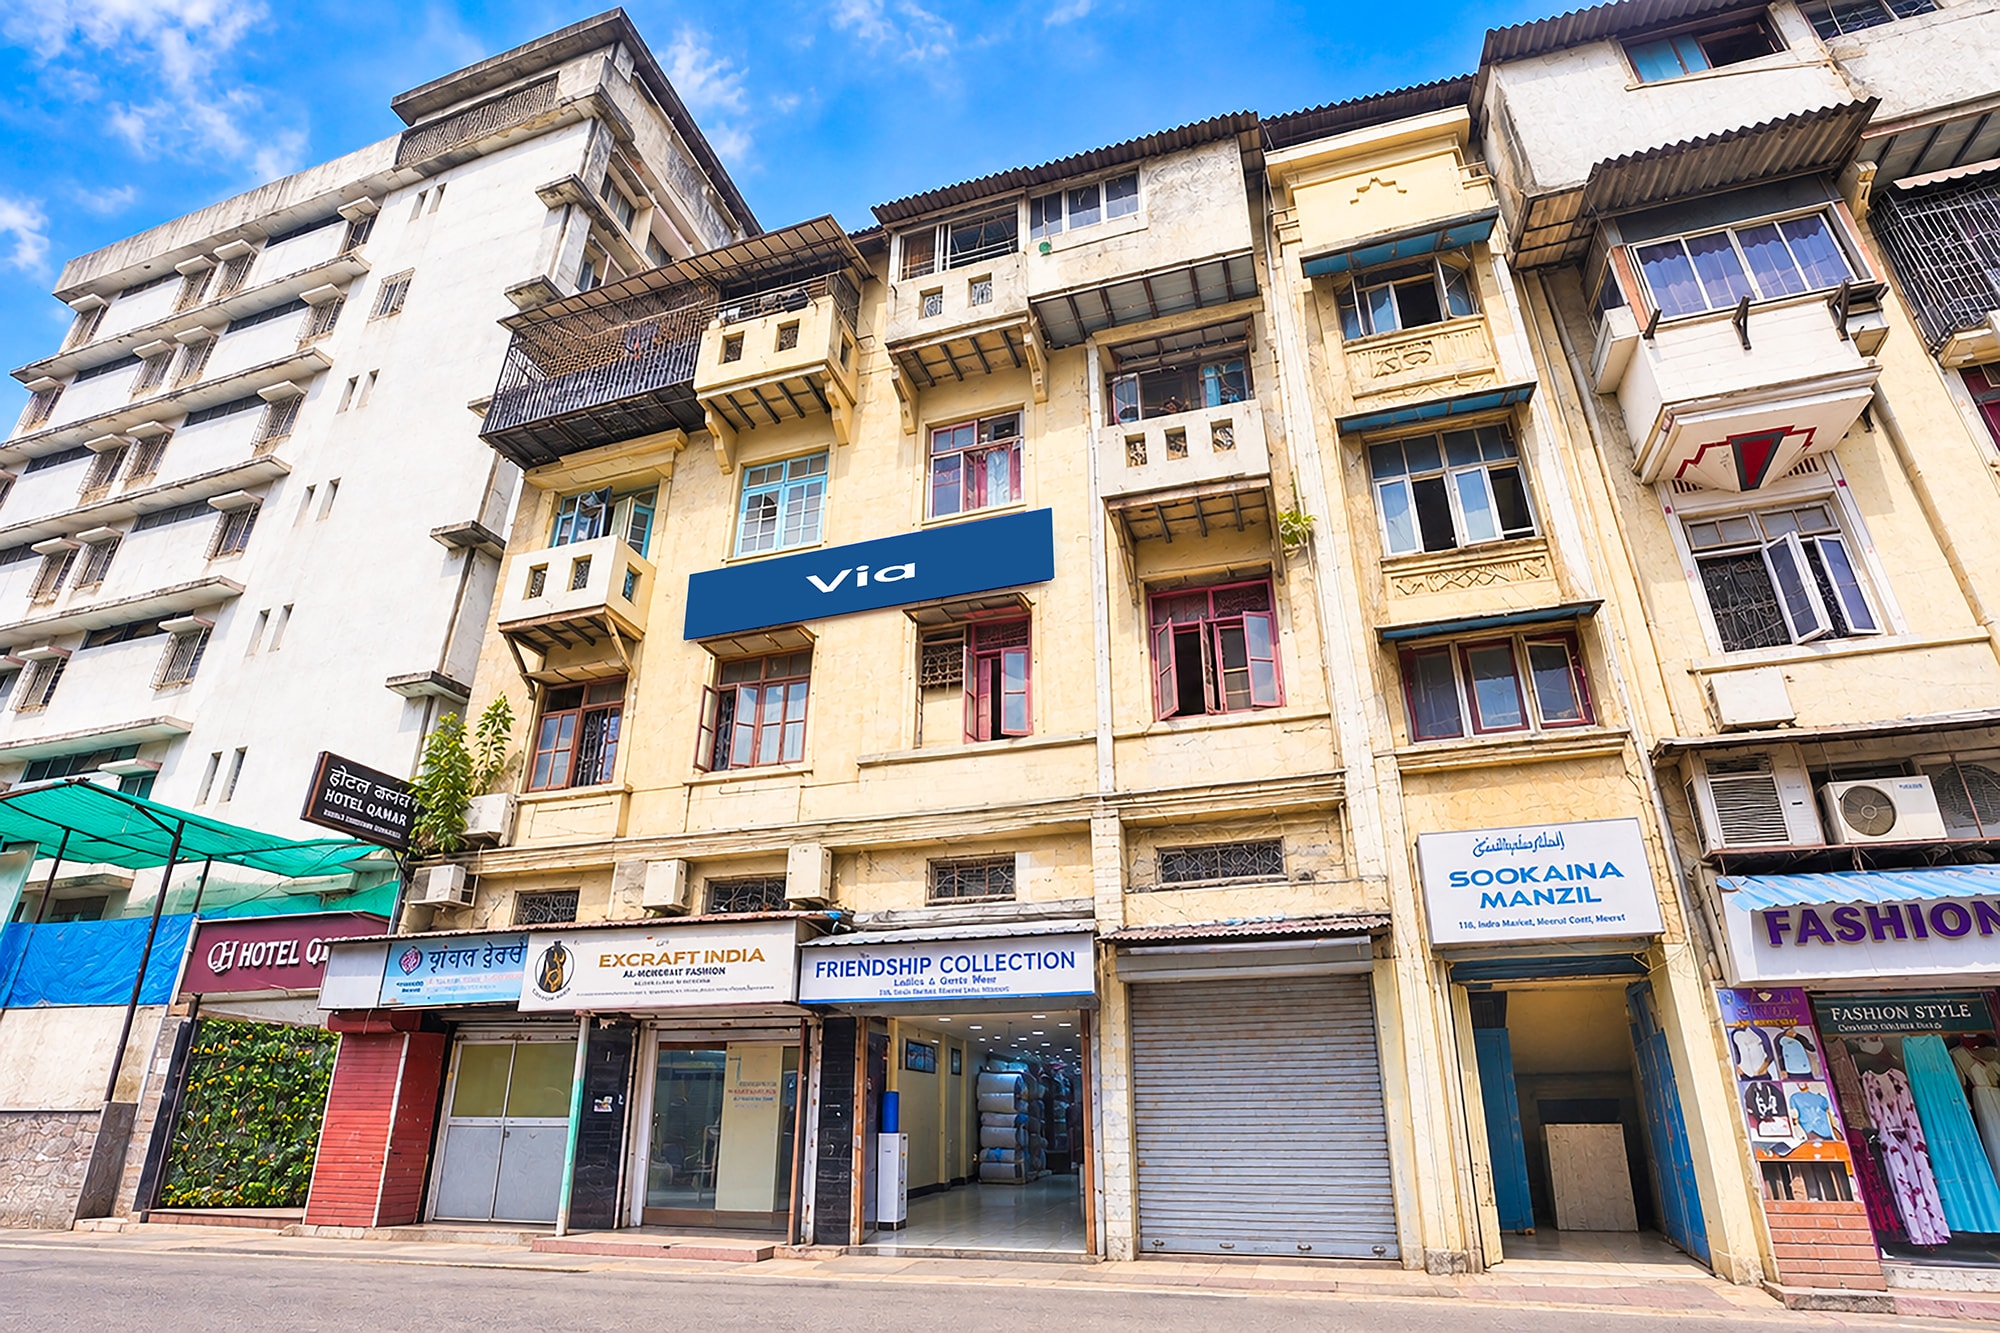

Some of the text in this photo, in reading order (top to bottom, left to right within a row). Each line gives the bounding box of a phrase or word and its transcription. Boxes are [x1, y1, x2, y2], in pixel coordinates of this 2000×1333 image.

[806, 562, 916, 594] Via
[329, 765, 372, 795] होटल
[324, 788, 364, 813] HOTEL
[366, 803, 408, 827] QAMAR
[1449, 861, 1625, 888] SOOKAINA
[1480, 886, 1602, 909] MANZIL
[238, 940, 300, 967] HOTEL
[598, 948, 766, 968] EXCRAFT INDIA
[815, 951, 1075, 979] FRIENDSHIP COLLECTION
[1830, 1003, 1972, 1021] FASHION STYLE
